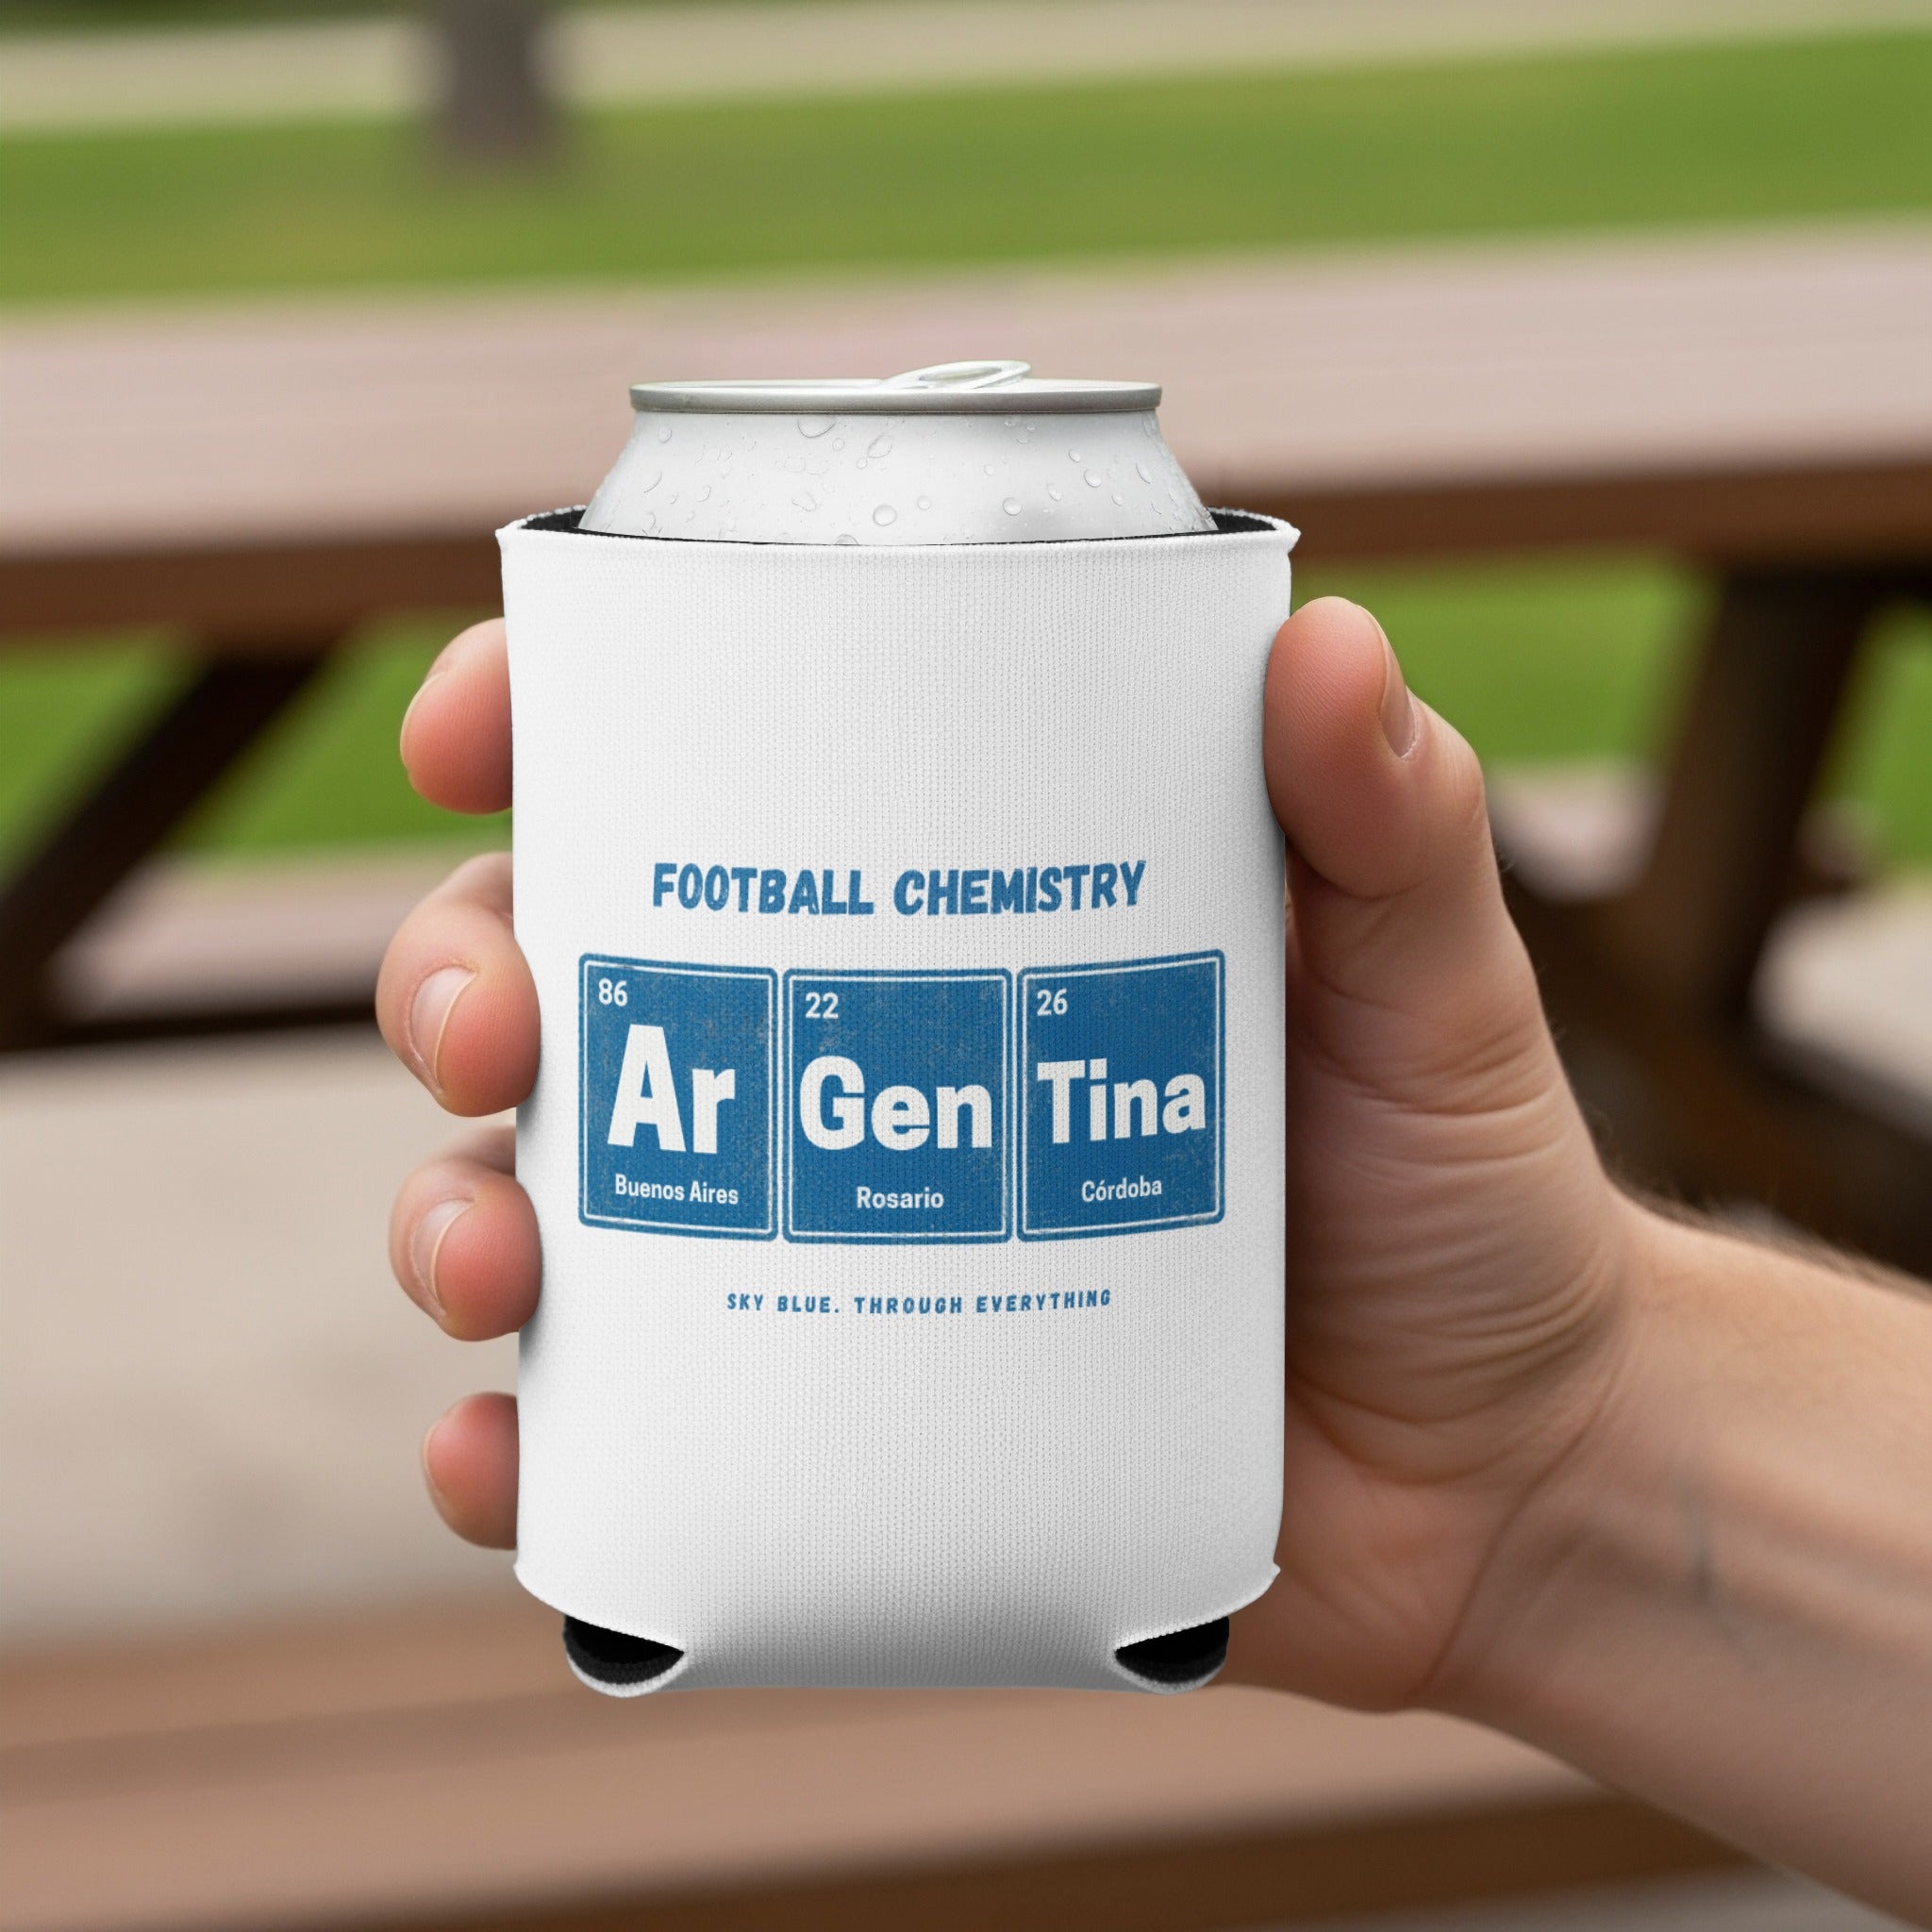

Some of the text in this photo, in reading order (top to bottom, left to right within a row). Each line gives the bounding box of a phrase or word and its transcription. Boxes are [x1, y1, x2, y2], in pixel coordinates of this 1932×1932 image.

[653, 860, 1146, 916] FOOTBALL CHEMISTRY
[598, 978, 628, 1008] 86
[805, 991, 839, 1020] 22
[1037, 988, 1068, 1016] 26
[607, 1024, 736, 1155] Ar
[799, 1055, 992, 1151] Gen
[1037, 1058, 1206, 1144] Tina
[615, 1173, 739, 1206] Buenos Aires
[857, 1186, 944, 1209] Rosario
[1081, 1175, 1162, 1203] Córdoba
[727, 1289, 1111, 1314] SKY BLUE. THROUGH EVERYTHING
